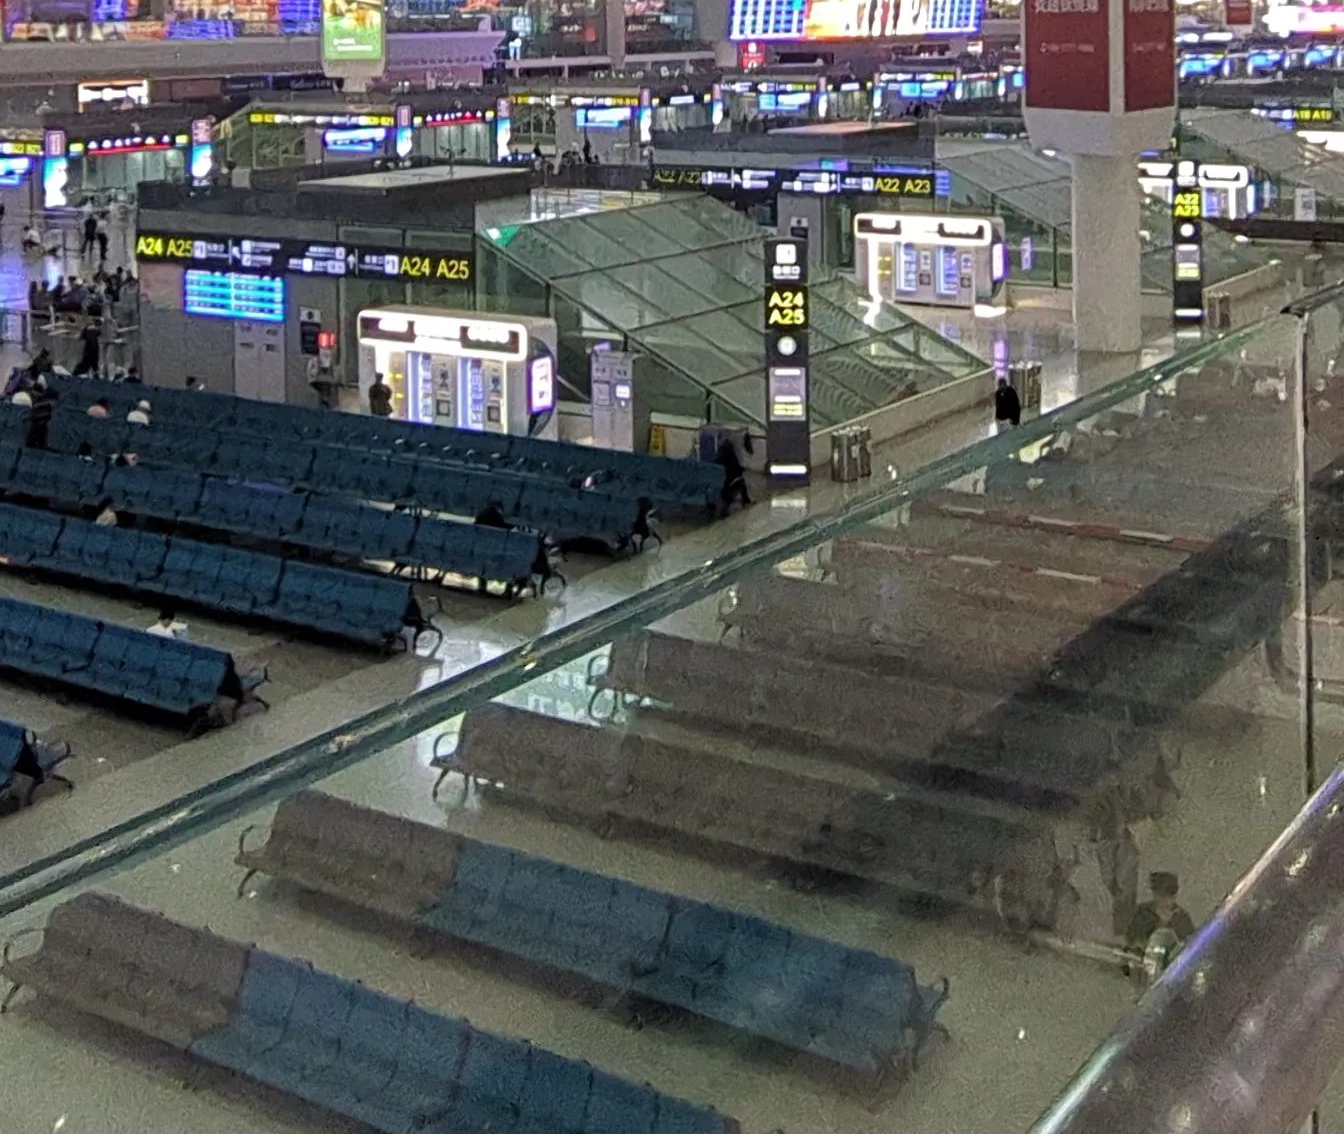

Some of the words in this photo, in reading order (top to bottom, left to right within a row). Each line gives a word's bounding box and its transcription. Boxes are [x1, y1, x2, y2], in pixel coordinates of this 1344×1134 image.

[875, 177, 900, 192] A22
[905, 179, 930, 193] A23
[136, 237, 162, 254] A24
[166, 239, 193, 257] A25
[400, 257, 430, 276] A24
[436, 259, 469, 279] A25
[769, 291, 804, 307] A24
[769, 308, 805, 324] A25
